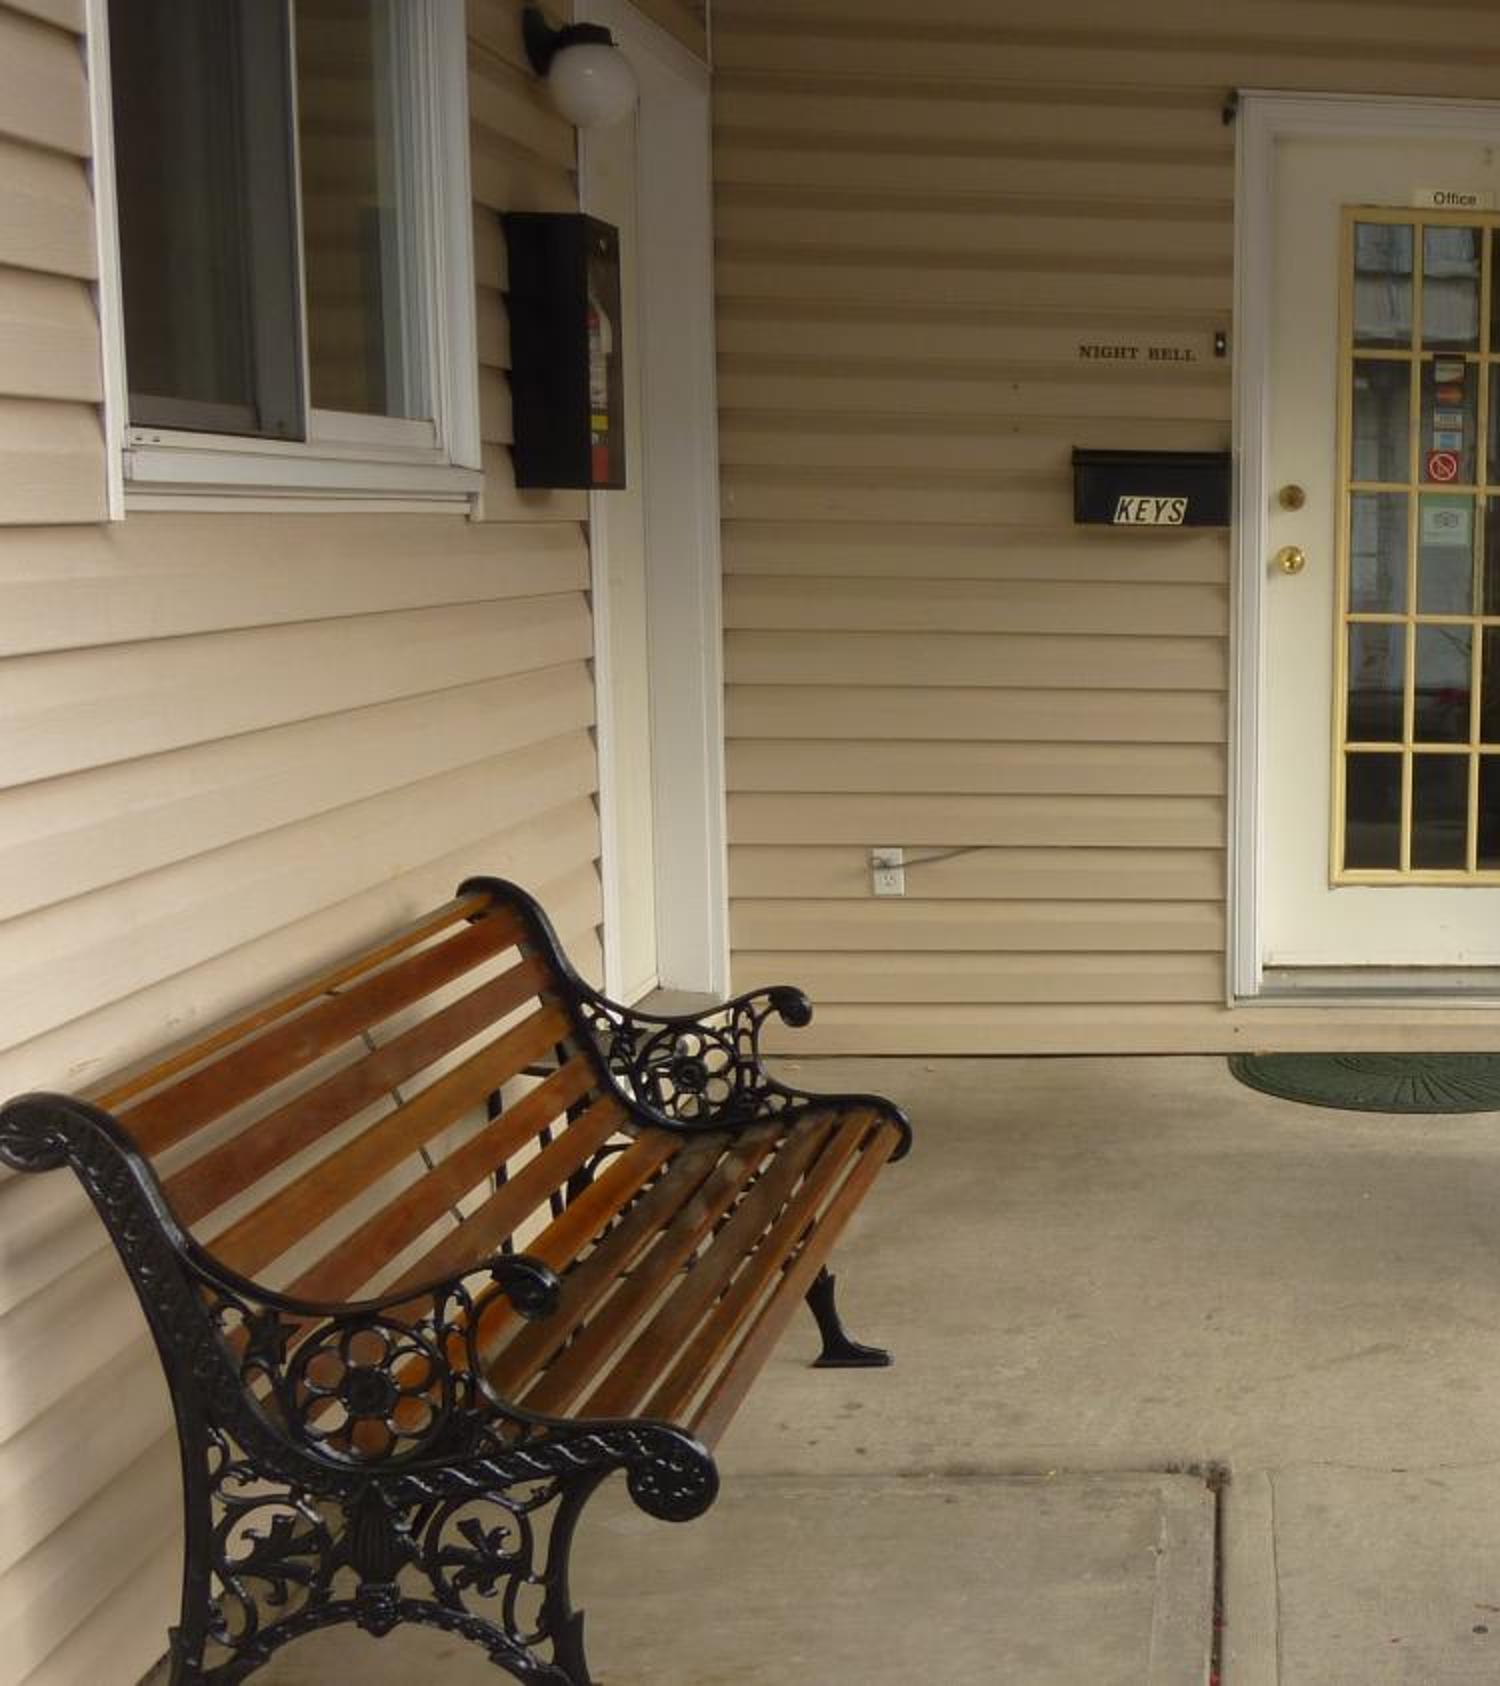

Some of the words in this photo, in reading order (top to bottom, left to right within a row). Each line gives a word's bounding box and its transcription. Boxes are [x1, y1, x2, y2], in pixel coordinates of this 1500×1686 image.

[1433, 191, 1477, 206] Office
[1080, 345, 1139, 360] NIGHT
[1149, 346, 1197, 362] BELL
[1117, 498, 1185, 523] KEYS
